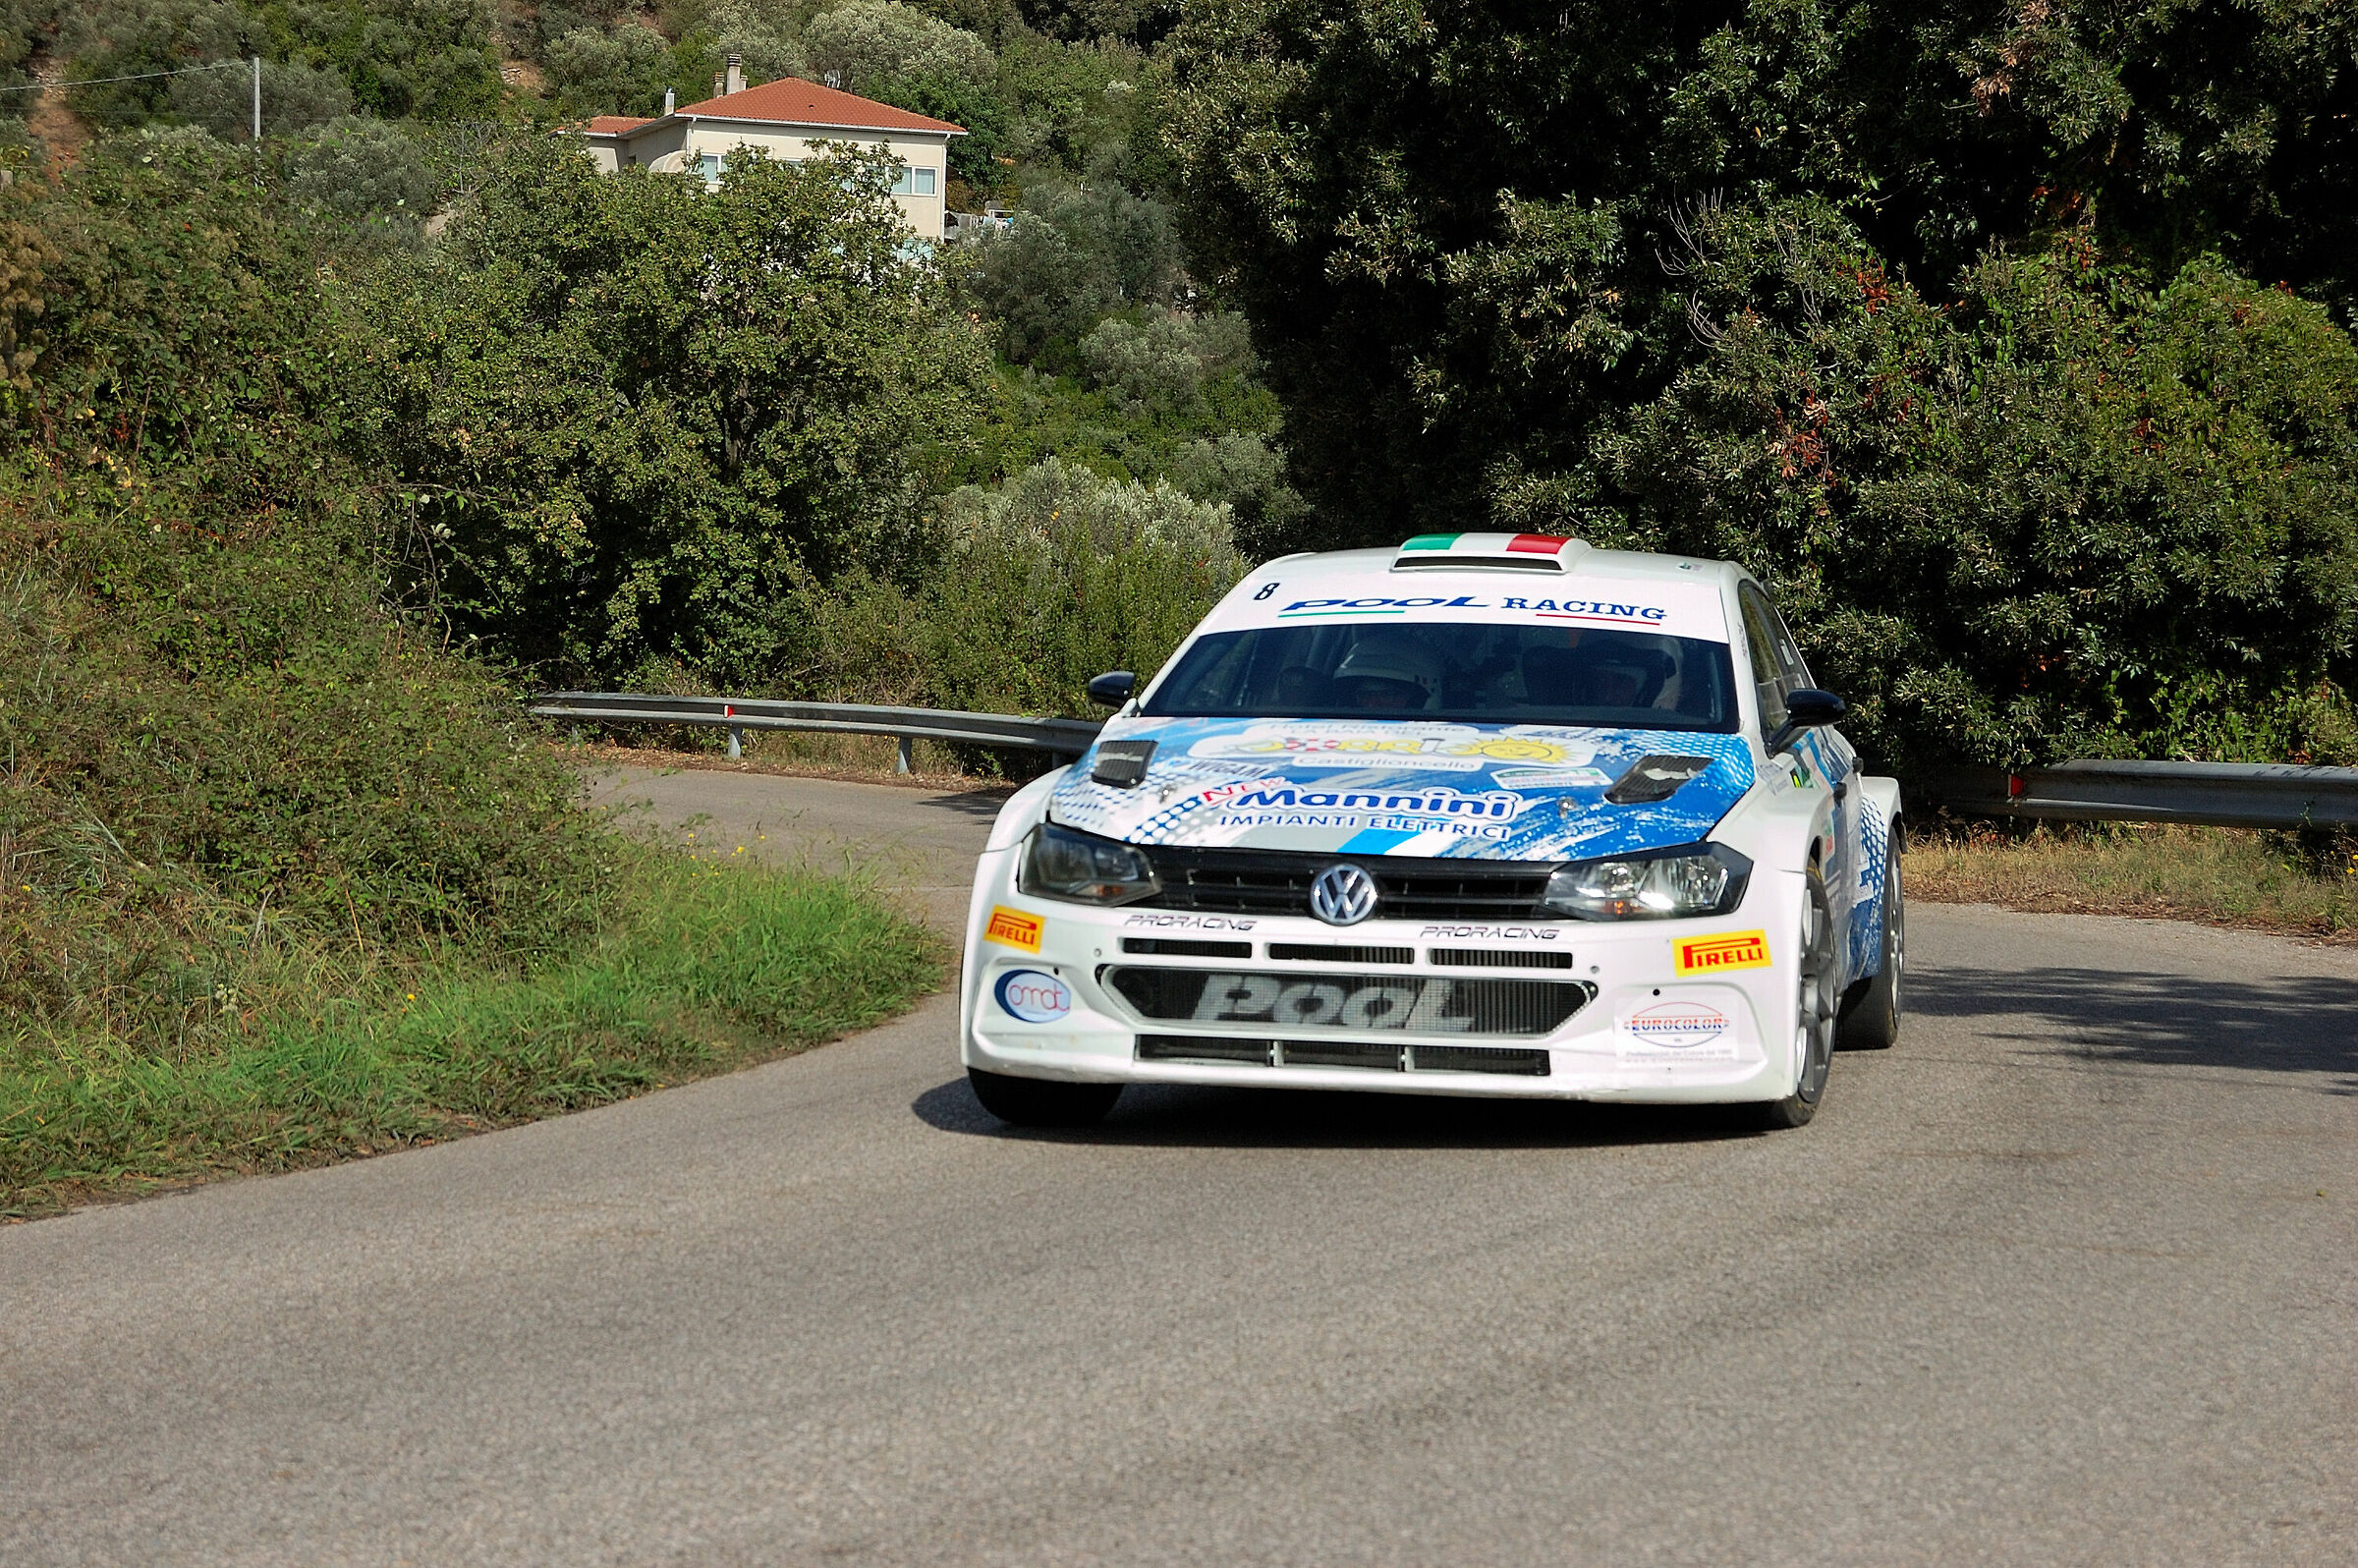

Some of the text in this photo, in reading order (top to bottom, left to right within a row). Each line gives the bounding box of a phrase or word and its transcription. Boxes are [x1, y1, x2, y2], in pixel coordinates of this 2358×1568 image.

[1253, 582, 1279, 601] 8
[1501, 596, 1668, 621] RACING
[1298, 756, 1476, 769] Castiglioncello
[1236, 789, 1507, 817] Mannini
[1220, 814, 1508, 839] IMPIANTI ELETTRICI
[988, 912, 1037, 945] PIRELLI
[1124, 914, 1259, 931] PRORACING
[1420, 925, 1560, 940] PRORACING
[1683, 936, 1764, 969] PIRELLI
[1191, 975, 1475, 1032] POOL
[1631, 1017, 1722, 1032] EUROCOLOR
